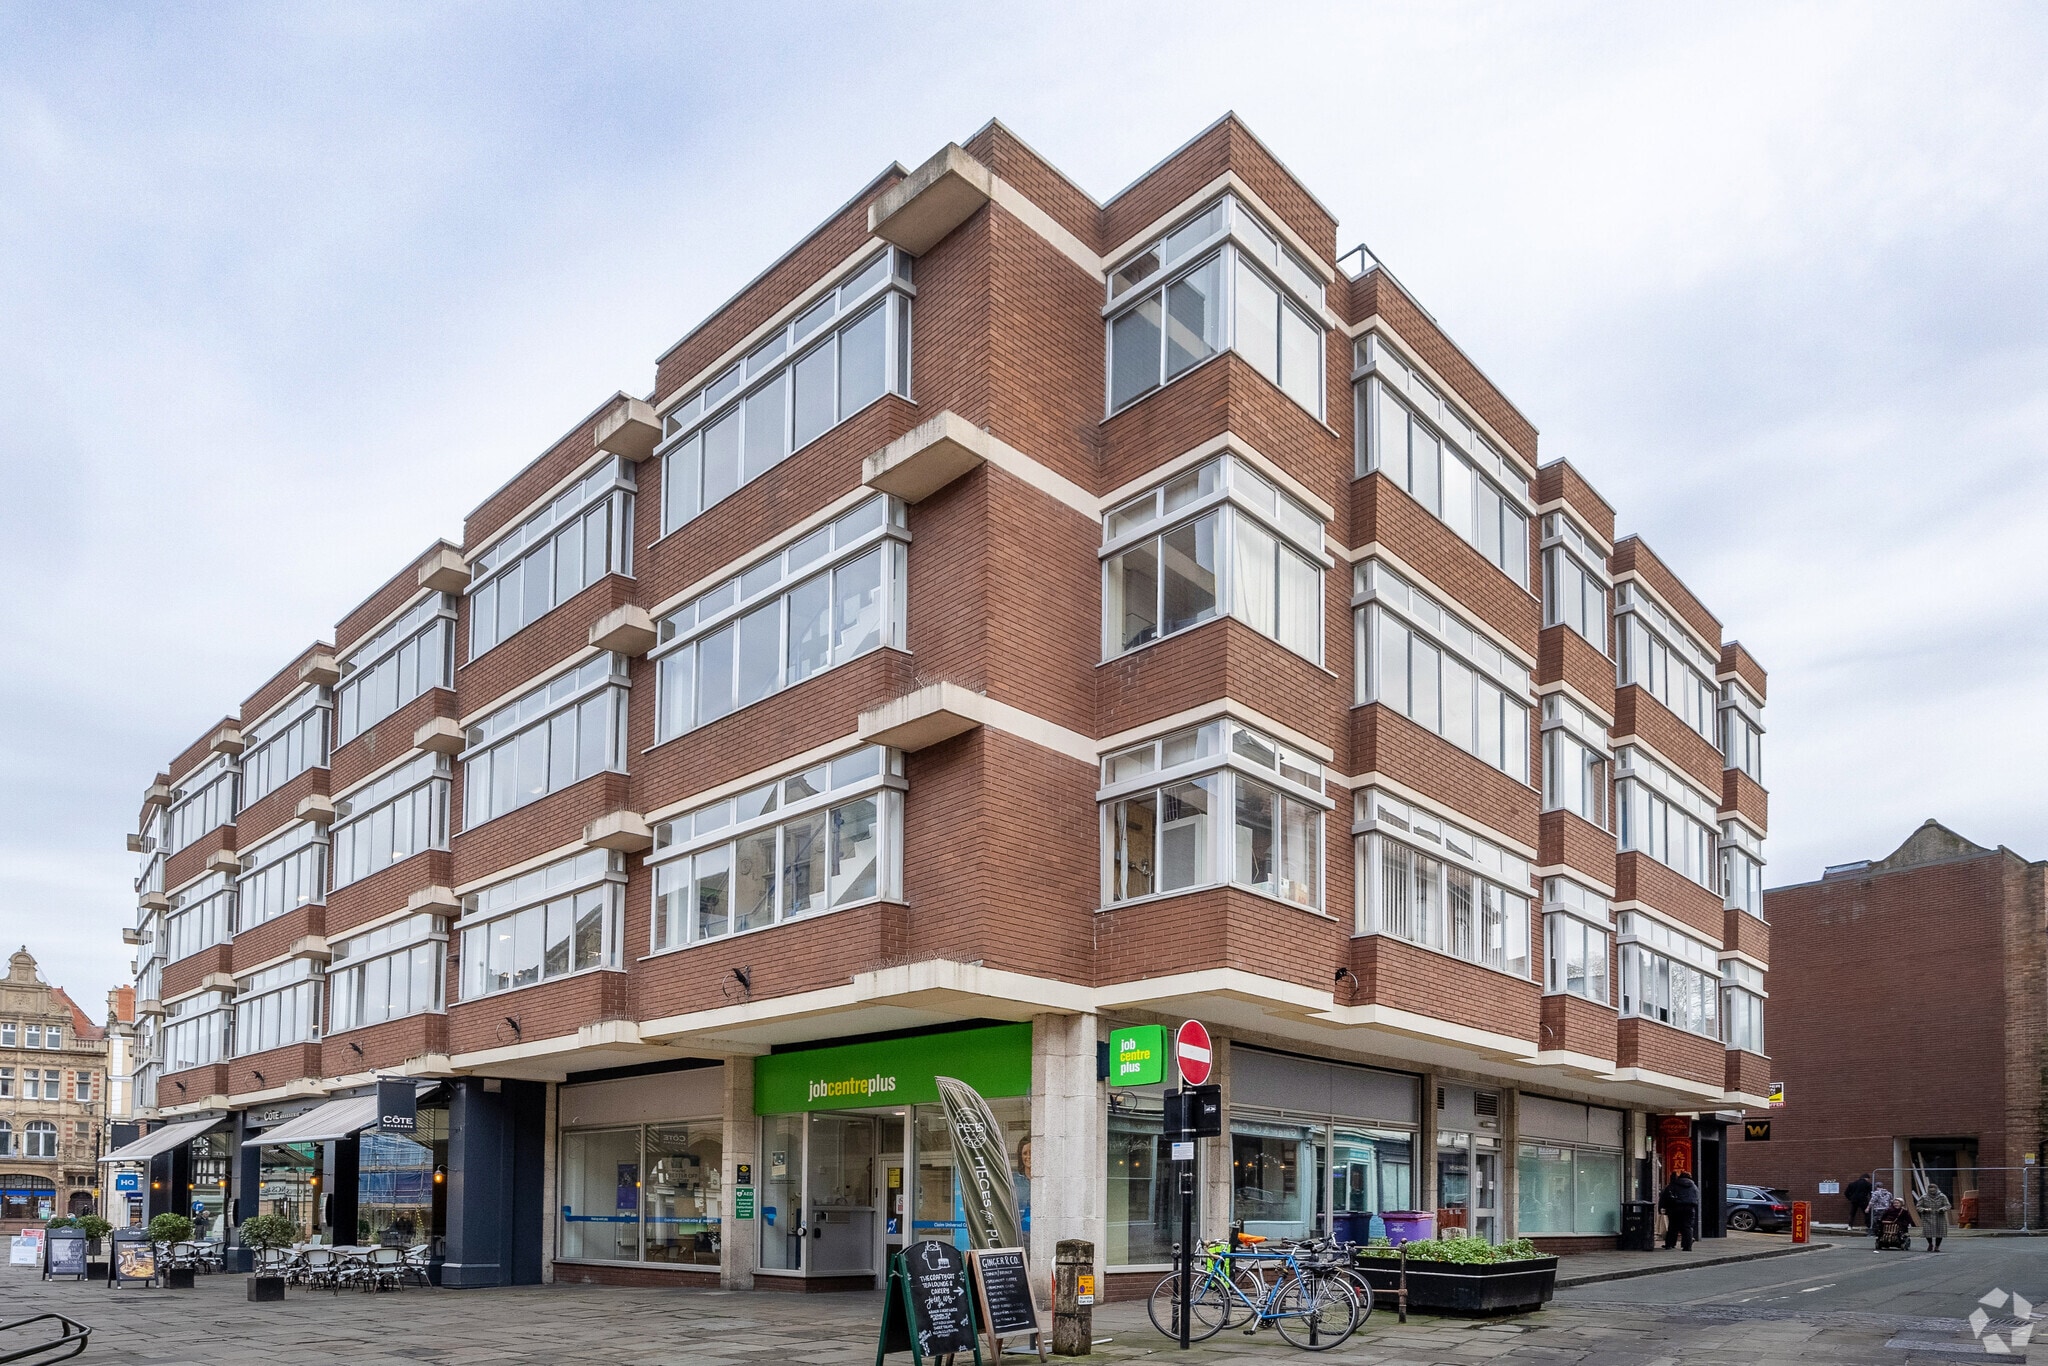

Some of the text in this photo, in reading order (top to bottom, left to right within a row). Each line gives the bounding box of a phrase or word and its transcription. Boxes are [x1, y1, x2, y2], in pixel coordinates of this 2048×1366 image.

[1120, 1038, 1136, 1053] job
[1120, 1049, 1151, 1062] centre
[1120, 1061, 1141, 1076] plus
[808, 1074, 896, 1102] jobcentreplus
[382, 1114, 414, 1125] CÔTE
[1795, 1214, 1804, 1238] OPEN
[985, 1229, 999, 1249] PL
[982, 1256, 1005, 1269] GINGER
